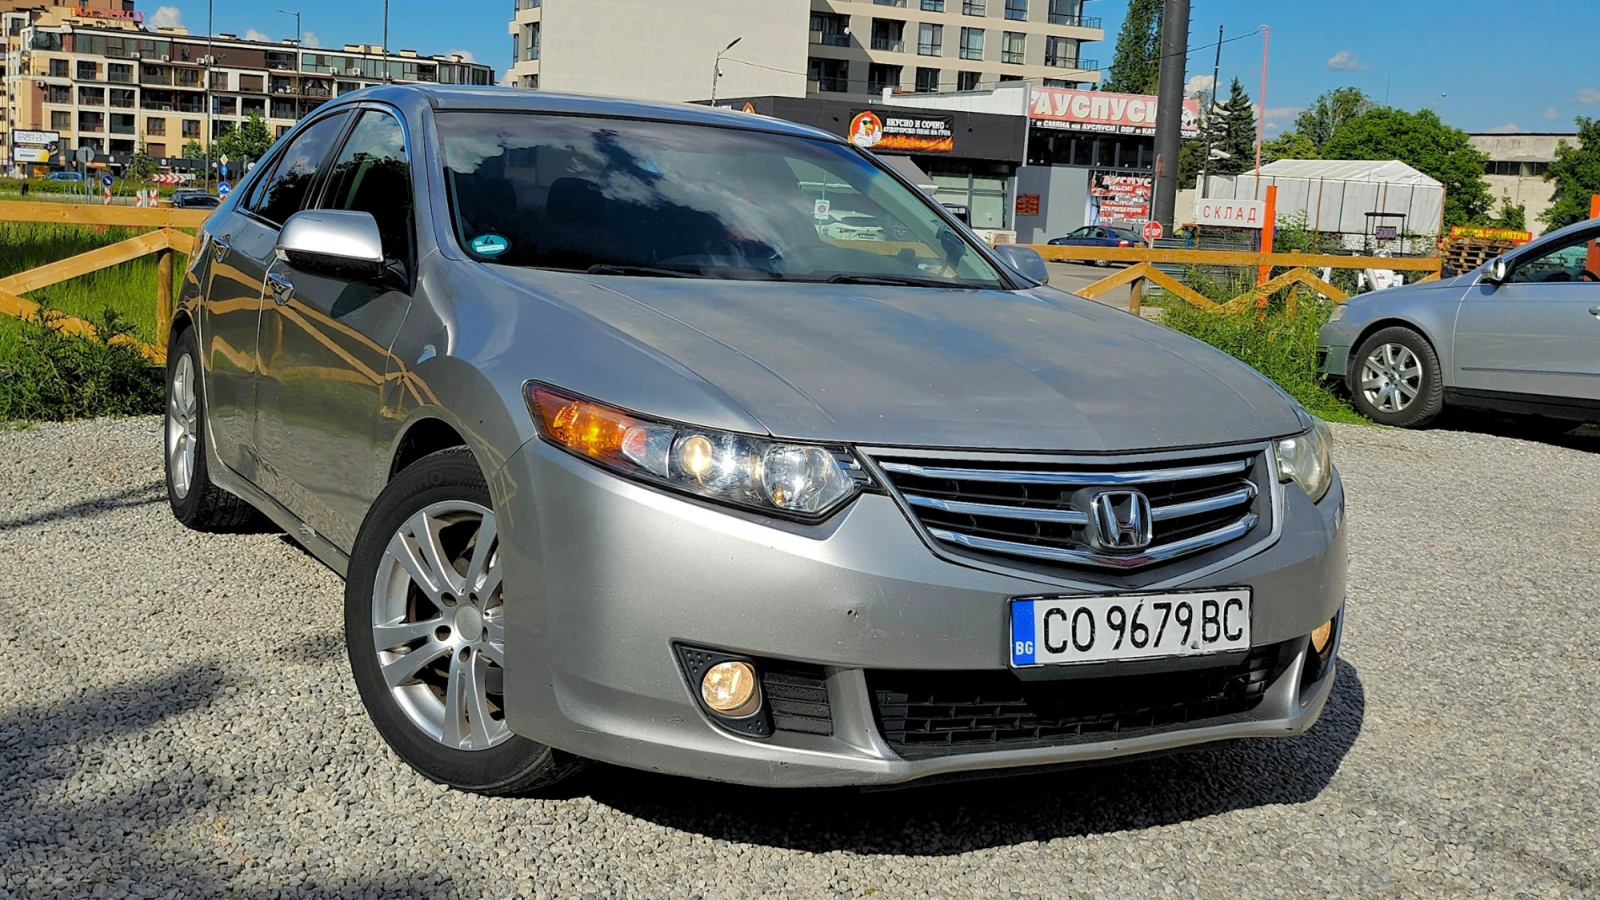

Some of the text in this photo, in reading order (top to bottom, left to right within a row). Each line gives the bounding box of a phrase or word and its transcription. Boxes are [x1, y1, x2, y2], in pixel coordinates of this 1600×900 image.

[886, 118, 944, 129] ВКУСНО И СОЧНО
[1043, 120, 1070, 128] СМЯНА
[1081, 123, 1115, 131] АУСПУСИ
[1203, 205, 1256, 223] СКЛАД
[1144, 228, 1161, 236] STOP
[1043, 598, 1243, 654] CO 9679 BC
[1015, 641, 1034, 655] BG
